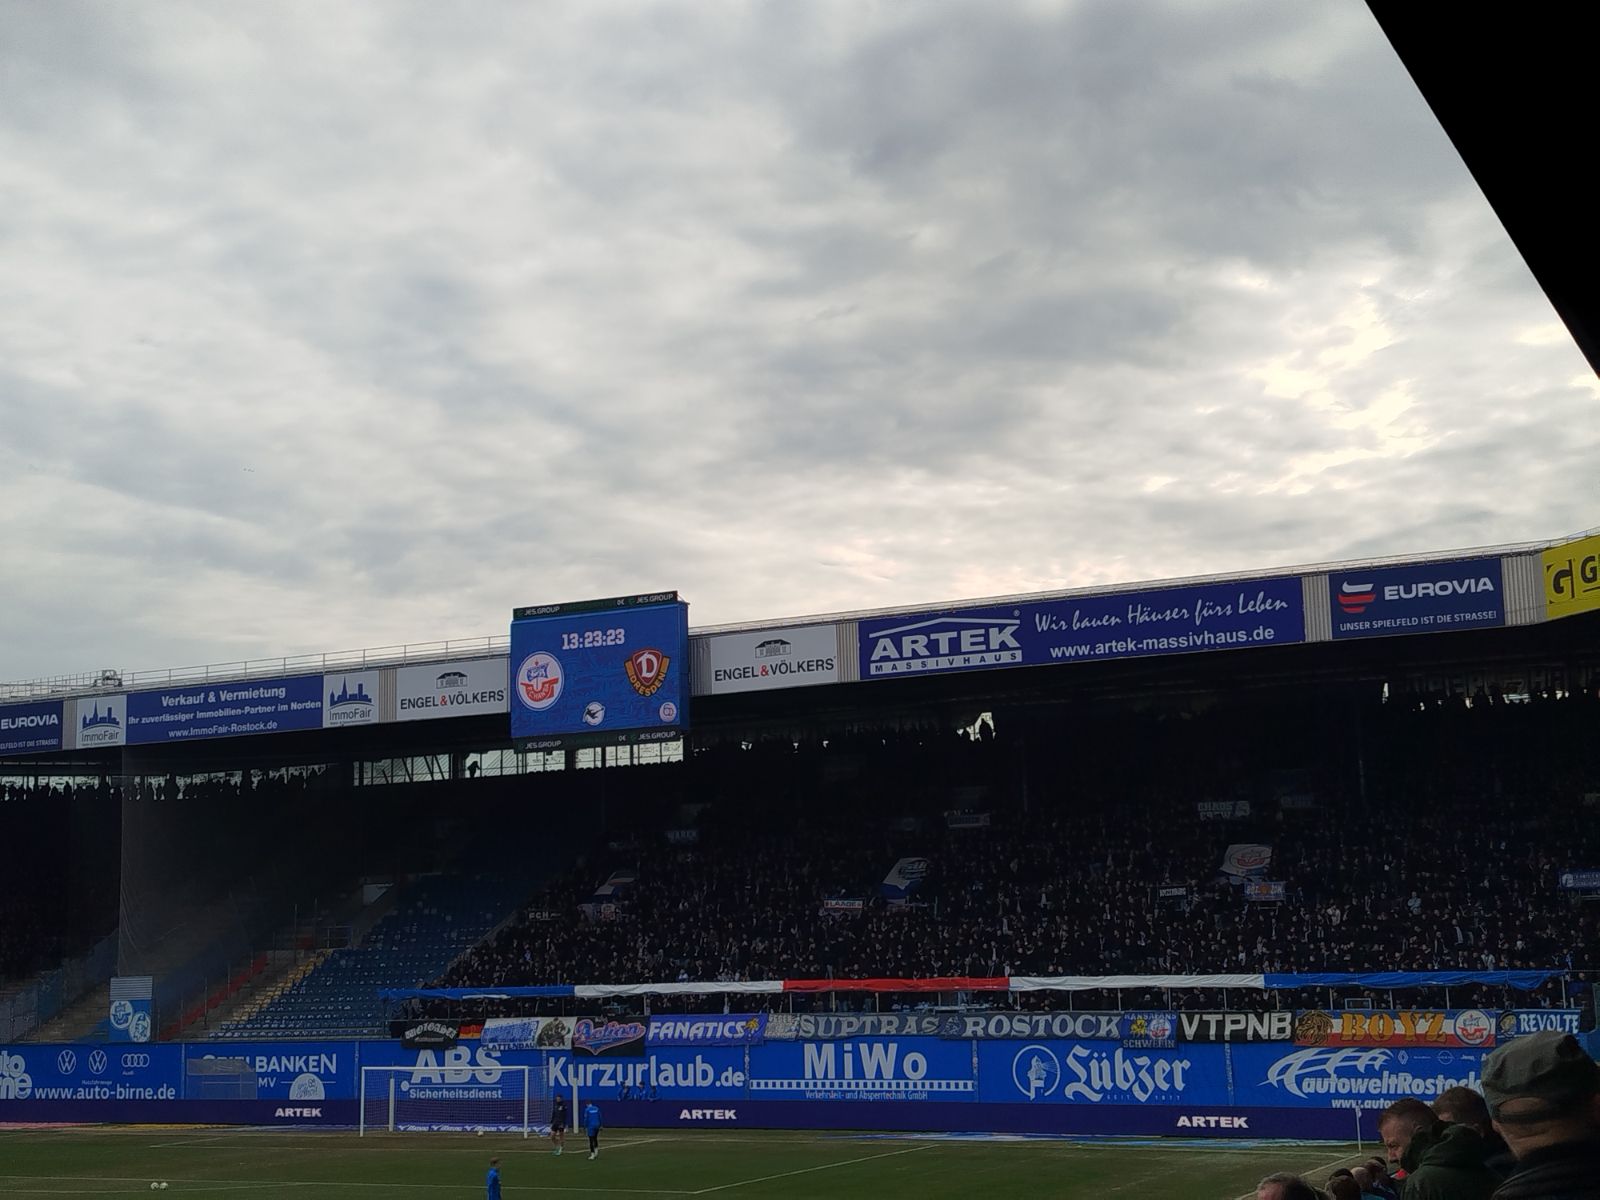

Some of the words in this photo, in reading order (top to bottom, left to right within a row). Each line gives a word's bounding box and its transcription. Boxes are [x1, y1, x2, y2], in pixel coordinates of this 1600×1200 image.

[1384, 576, 1494, 601] EUROVIA
[1035, 612, 1068, 632] Wir
[1072, 609, 1122, 630] bauen
[1128, 604, 1189, 626] Häuser
[1195, 599, 1233, 626] fürs
[1238, 591, 1288, 615] Leben
[1340, 620, 1371, 631] UNSER
[1371, 616, 1419, 628] SPIELFELD
[1420, 615, 1435, 625] IST
[1437, 614, 1453, 624] DIE
[561, 628, 625, 650] 13:23:23
[870, 623, 1023, 661] ARTEK
[1050, 625, 1275, 659] www.artek-massivhaus.de
[874, 651, 1018, 673] MASSIVHAUS
[162, 693, 206, 708] Verkauf
[208, 692, 216, 703] &
[219, 685, 286, 704] Vermietung
[0, 713, 59, 730] EUROVIA
[128, 715, 140, 725] Ihr
[141, 710, 195, 725] zuverlässiger
[196, 704, 276, 720] Immobilien-Partner
[278, 703, 288, 712] im
[291, 700, 321, 711] Norden
[329, 707, 372, 721] ImmoFair
[81, 731, 120, 743] ImmoFair
[168, 720, 278, 739] www.ImmoFair-Rostock.de
[648, 1021, 746, 1041] FANATICS
[961, 1014, 1122, 1039] ROSTOCK
[1180, 1011, 1292, 1041] VTPNB
[1340, 1011, 1447, 1043] BOYZ
[1519, 1013, 1579, 1034] REVOLTE
[1122, 1039, 1175, 1049] SCHWERIN
[411, 1046, 503, 1084] ABS
[548, 1054, 745, 1087] Kurzurlaub.de
[803, 1043, 929, 1081] MiWo
[258, 1077, 276, 1088] MV
[1064, 1044, 1192, 1103] Lübzer
[0, 1072, 33, 1099] ne
[34, 1083, 176, 1100] www.auto-birne.de
[409, 1088, 503, 1100] Sicherheitsdienst
[274, 1107, 322, 1118] ARTEK
[679, 1109, 737, 1120] ARTEK
[1176, 1115, 1250, 1129] ARTEK
